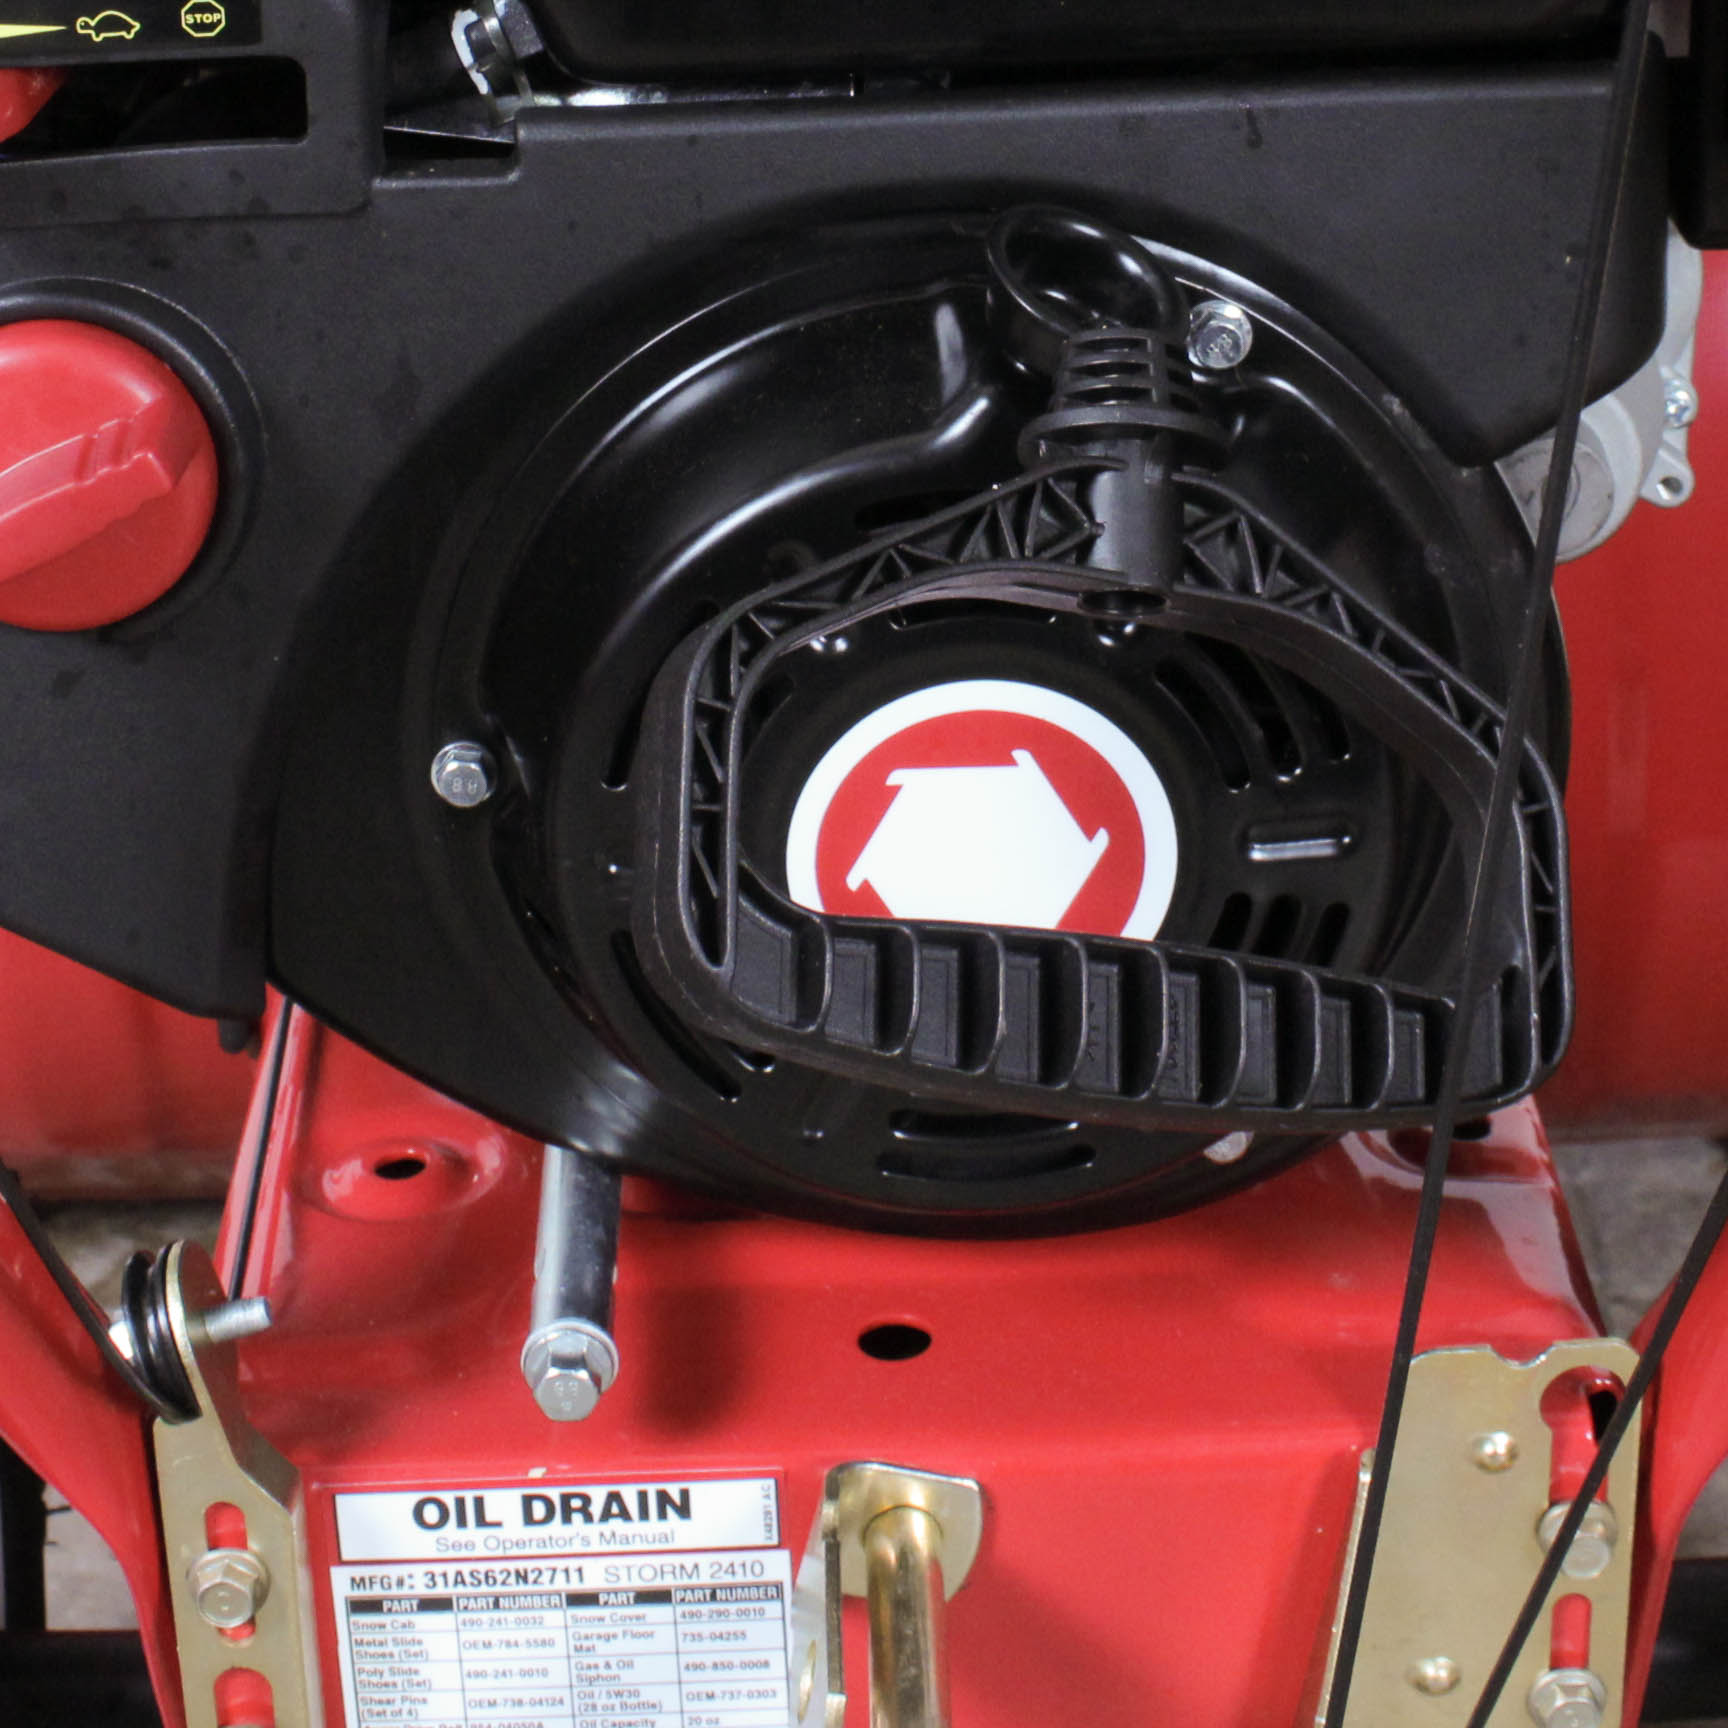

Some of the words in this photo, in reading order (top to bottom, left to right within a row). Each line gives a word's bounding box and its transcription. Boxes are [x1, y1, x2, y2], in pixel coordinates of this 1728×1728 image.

[185, 12, 221, 24] STOP
[412, 1495, 504, 1530] OIL
[521, 1487, 692, 1526] DRAIN
[435, 1537, 476, 1553] See
[483, 1532, 591, 1554] Operator's
[598, 1529, 675, 1547] Manual
[350, 1573, 415, 1591] MFG#:
[424, 1566, 584, 1589] 31AS62N2711
[604, 1562, 700, 1584] STORM
[709, 1560, 765, 1579] 2410
[598, 1592, 636, 1606] PART
[675, 1589, 712, 1603] PART
[715, 1586, 778, 1601] NUMBER
[382, 1599, 419, 1613] PART
[459, 1597, 495, 1611] PART
[499, 1595, 561, 1609] NUMBER
[571, 1614, 606, 1624] Snow
[610, 1612, 647, 1623] Cover
[352, 1621, 387, 1631] Snow
[572, 1630, 619, 1642] Garage
[622, 1629, 656, 1640] Floor
[354, 1638, 388, 1648] Metal
[392, 1637, 424, 1647] Slide
[355, 1649, 395, 1660] Shoes
[398, 1648, 430, 1661] (Set)
[573, 1644, 596, 1654] Mat
[575, 1661, 600, 1671] Gas
[604, 1660, 613, 1670] &
[616, 1659, 635, 1670] Oil
[357, 1667, 384, 1678] Poly
[388, 1666, 421, 1677] Slide
[358, 1679, 398, 1690] Shoes
[401, 1678, 432, 1691] (Set)
[575, 1674, 621, 1686] Siphon
[360, 1695, 396, 1706] Shear
[400, 1695, 428, 1705] Pins
[577, 1689, 595, 1700] Oil
[390, 1707, 404, 1718] of
